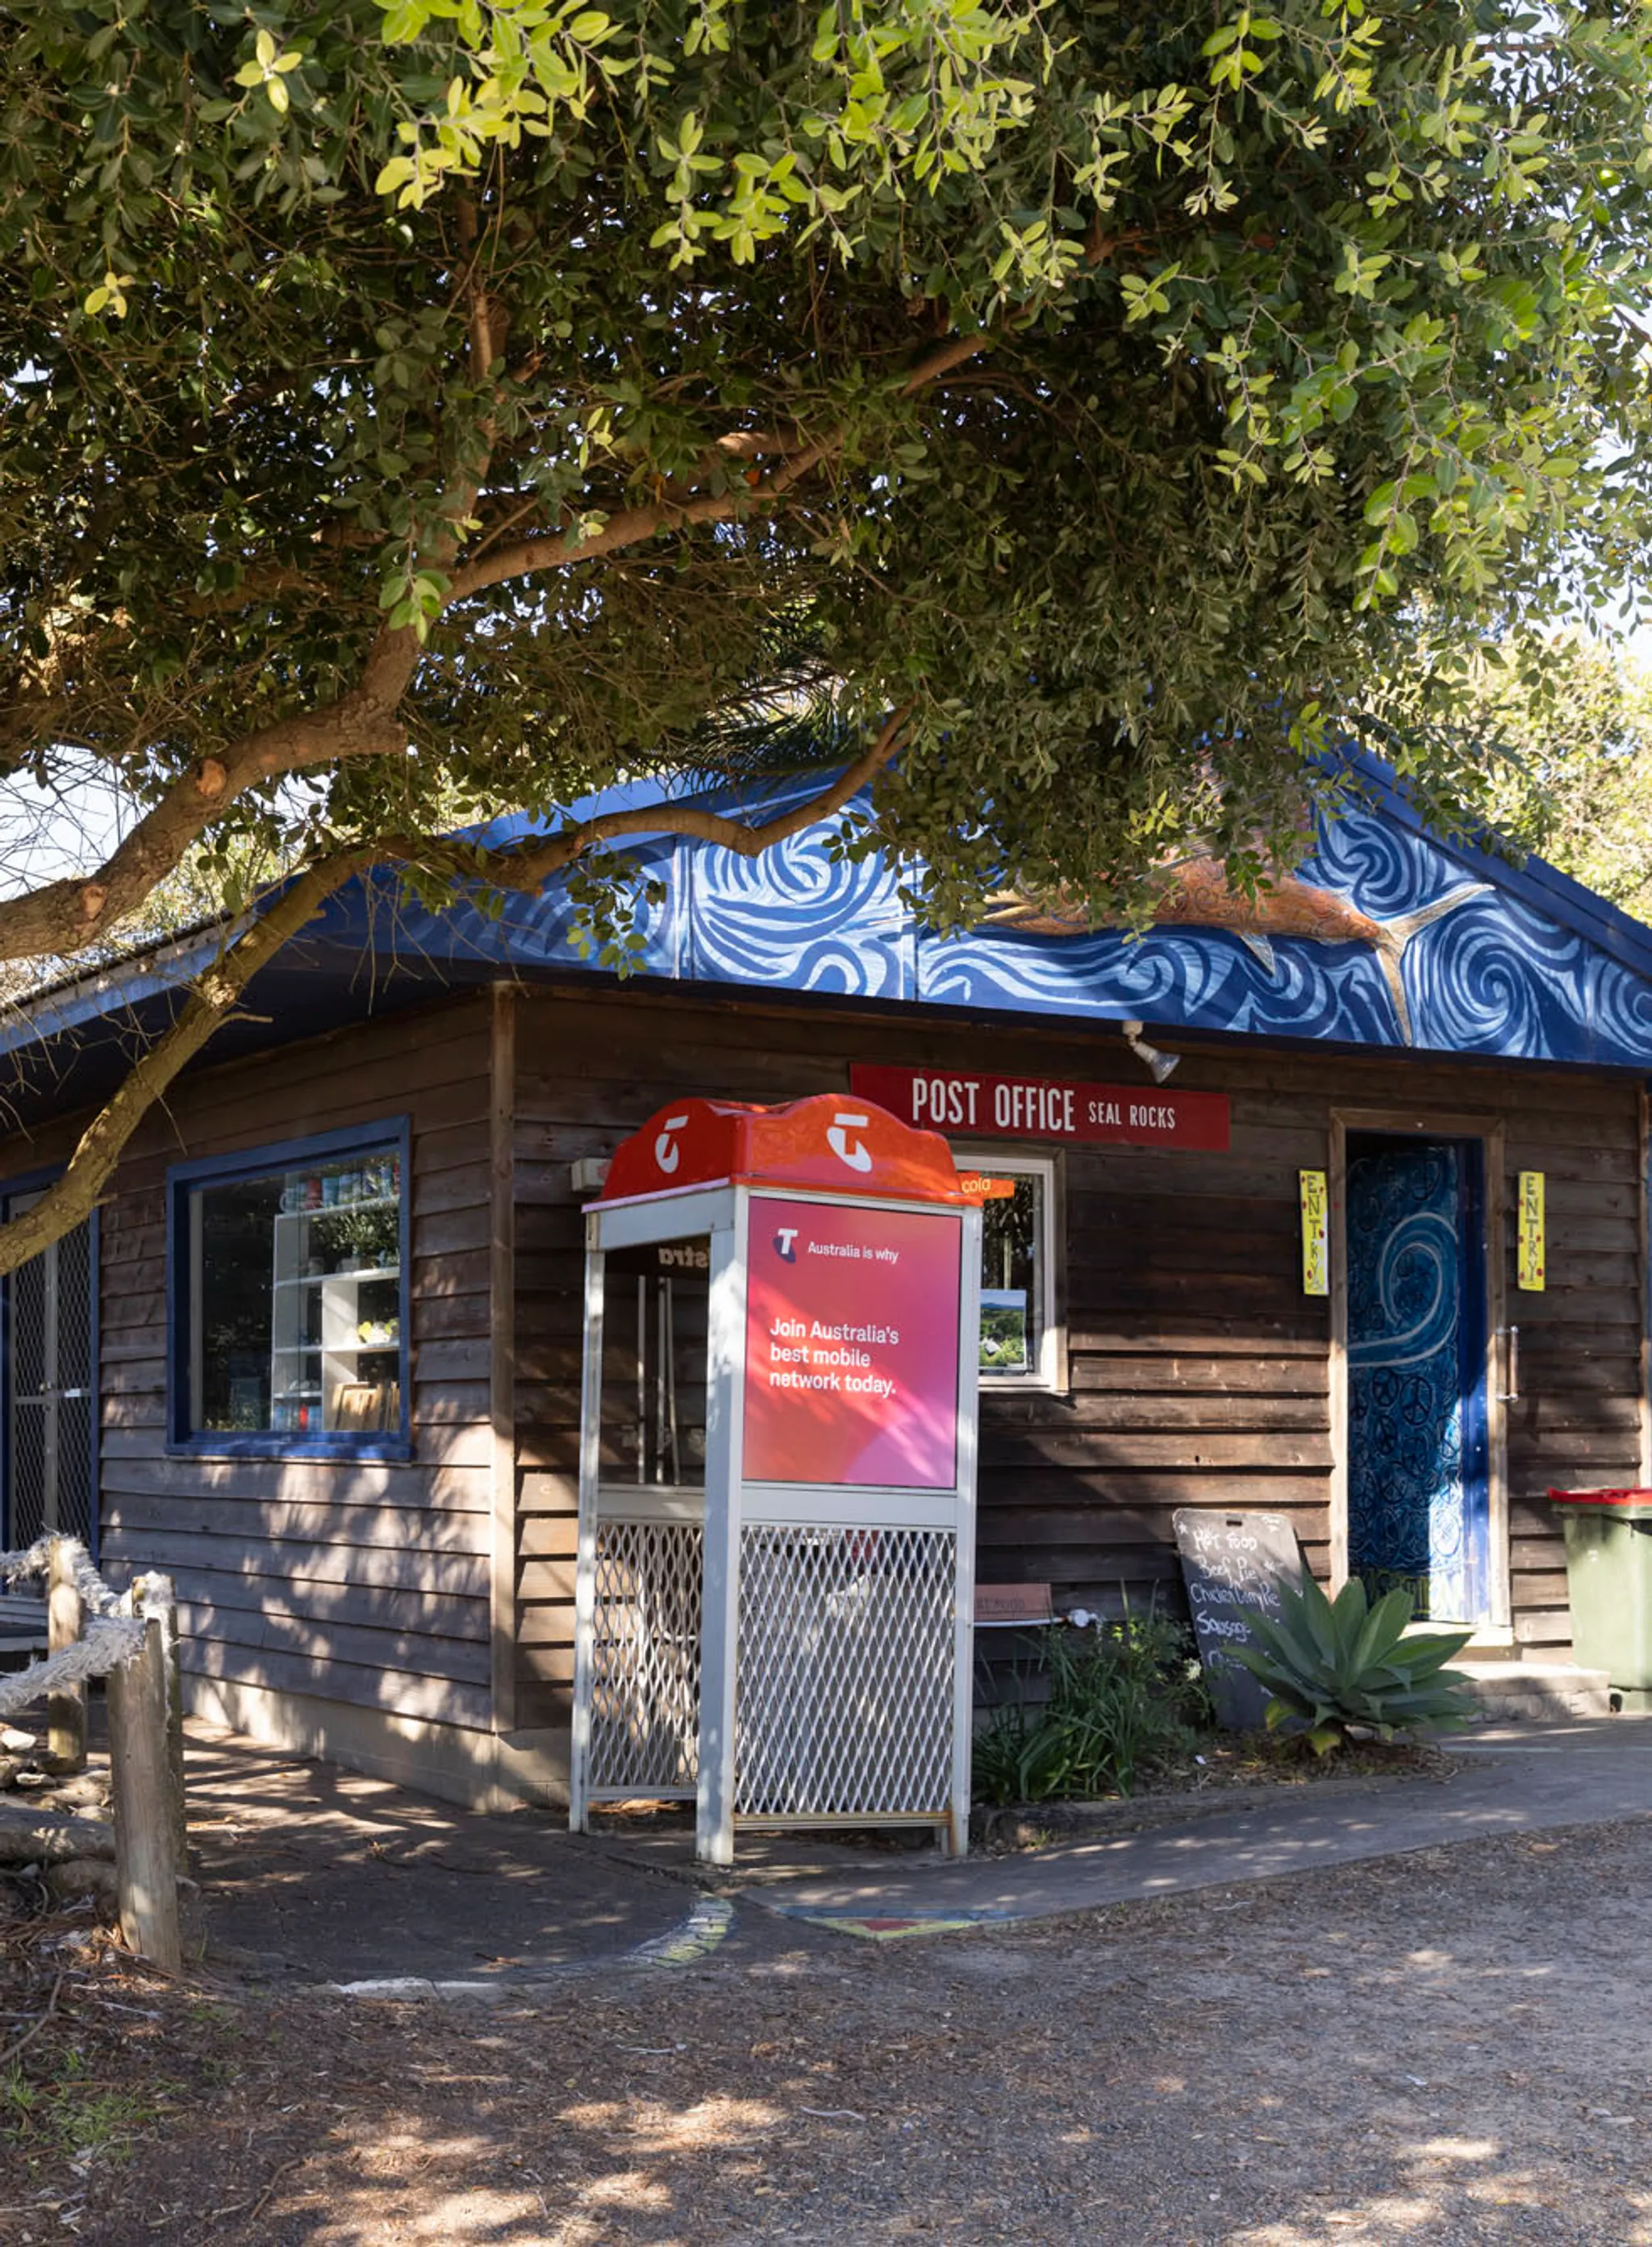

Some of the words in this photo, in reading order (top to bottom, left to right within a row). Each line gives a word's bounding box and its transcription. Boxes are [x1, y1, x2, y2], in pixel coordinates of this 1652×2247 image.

[912, 1078, 979, 1126] POST
[995, 1084, 1075, 1131] OFFICE
[1089, 1101, 1122, 1125] SEAL
[1130, 1105, 1175, 1129] ROCKS
[1306, 1174, 1321, 1276] ENTRY
[1525, 1175, 1539, 1281] ENTRY
[808, 1242, 861, 1258] Australia
[862, 1246, 874, 1259] is
[875, 1247, 899, 1265] why
[770, 1317, 806, 1338] Join
[810, 1321, 899, 1345] Australia's
[770, 1342, 810, 1363] best
[813, 1347, 871, 1367] mobile
[769, 1371, 841, 1390] network
[845, 1374, 897, 1398] today.
[1195, 1554, 1233, 1587] Beef
[1236, 1556, 1258, 1582] Pie
